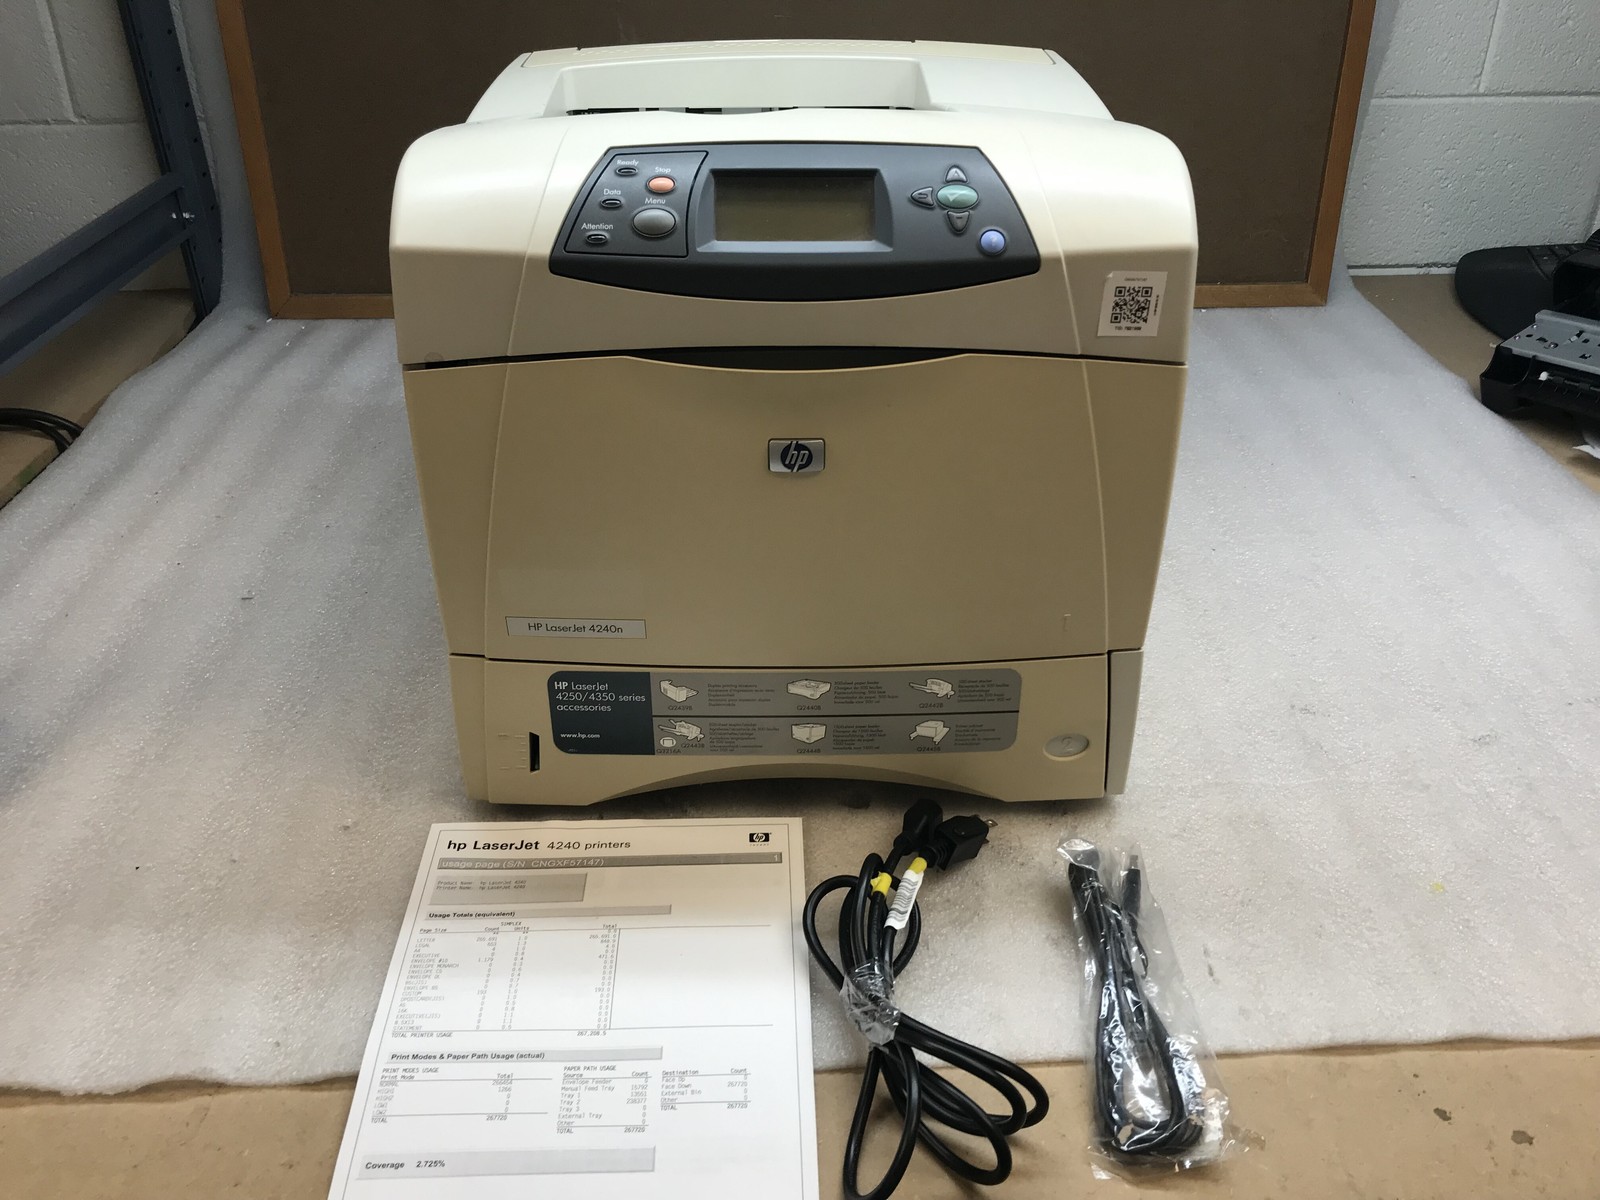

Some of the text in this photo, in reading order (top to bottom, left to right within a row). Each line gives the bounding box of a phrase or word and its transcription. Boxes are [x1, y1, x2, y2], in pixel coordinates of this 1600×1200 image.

[784, 441, 811, 472] hp
[528, 622, 623, 634] HP LaserJet 4240n
[554, 681, 608, 691] HP LaserJet
[556, 692, 646, 702] 4250/4350 series
[556, 704, 612, 712] accessories
[447, 840, 631, 852] hp LaserJet 4240 printers
[442, 860, 472, 869] usage
[474, 860, 500, 870] page
[447, 1053, 469, 1062] Paper
[490, 1052, 514, 1061] Usage
[516, 1052, 545, 1060] (actual)
[365, 1162, 405, 1170] Coverage
